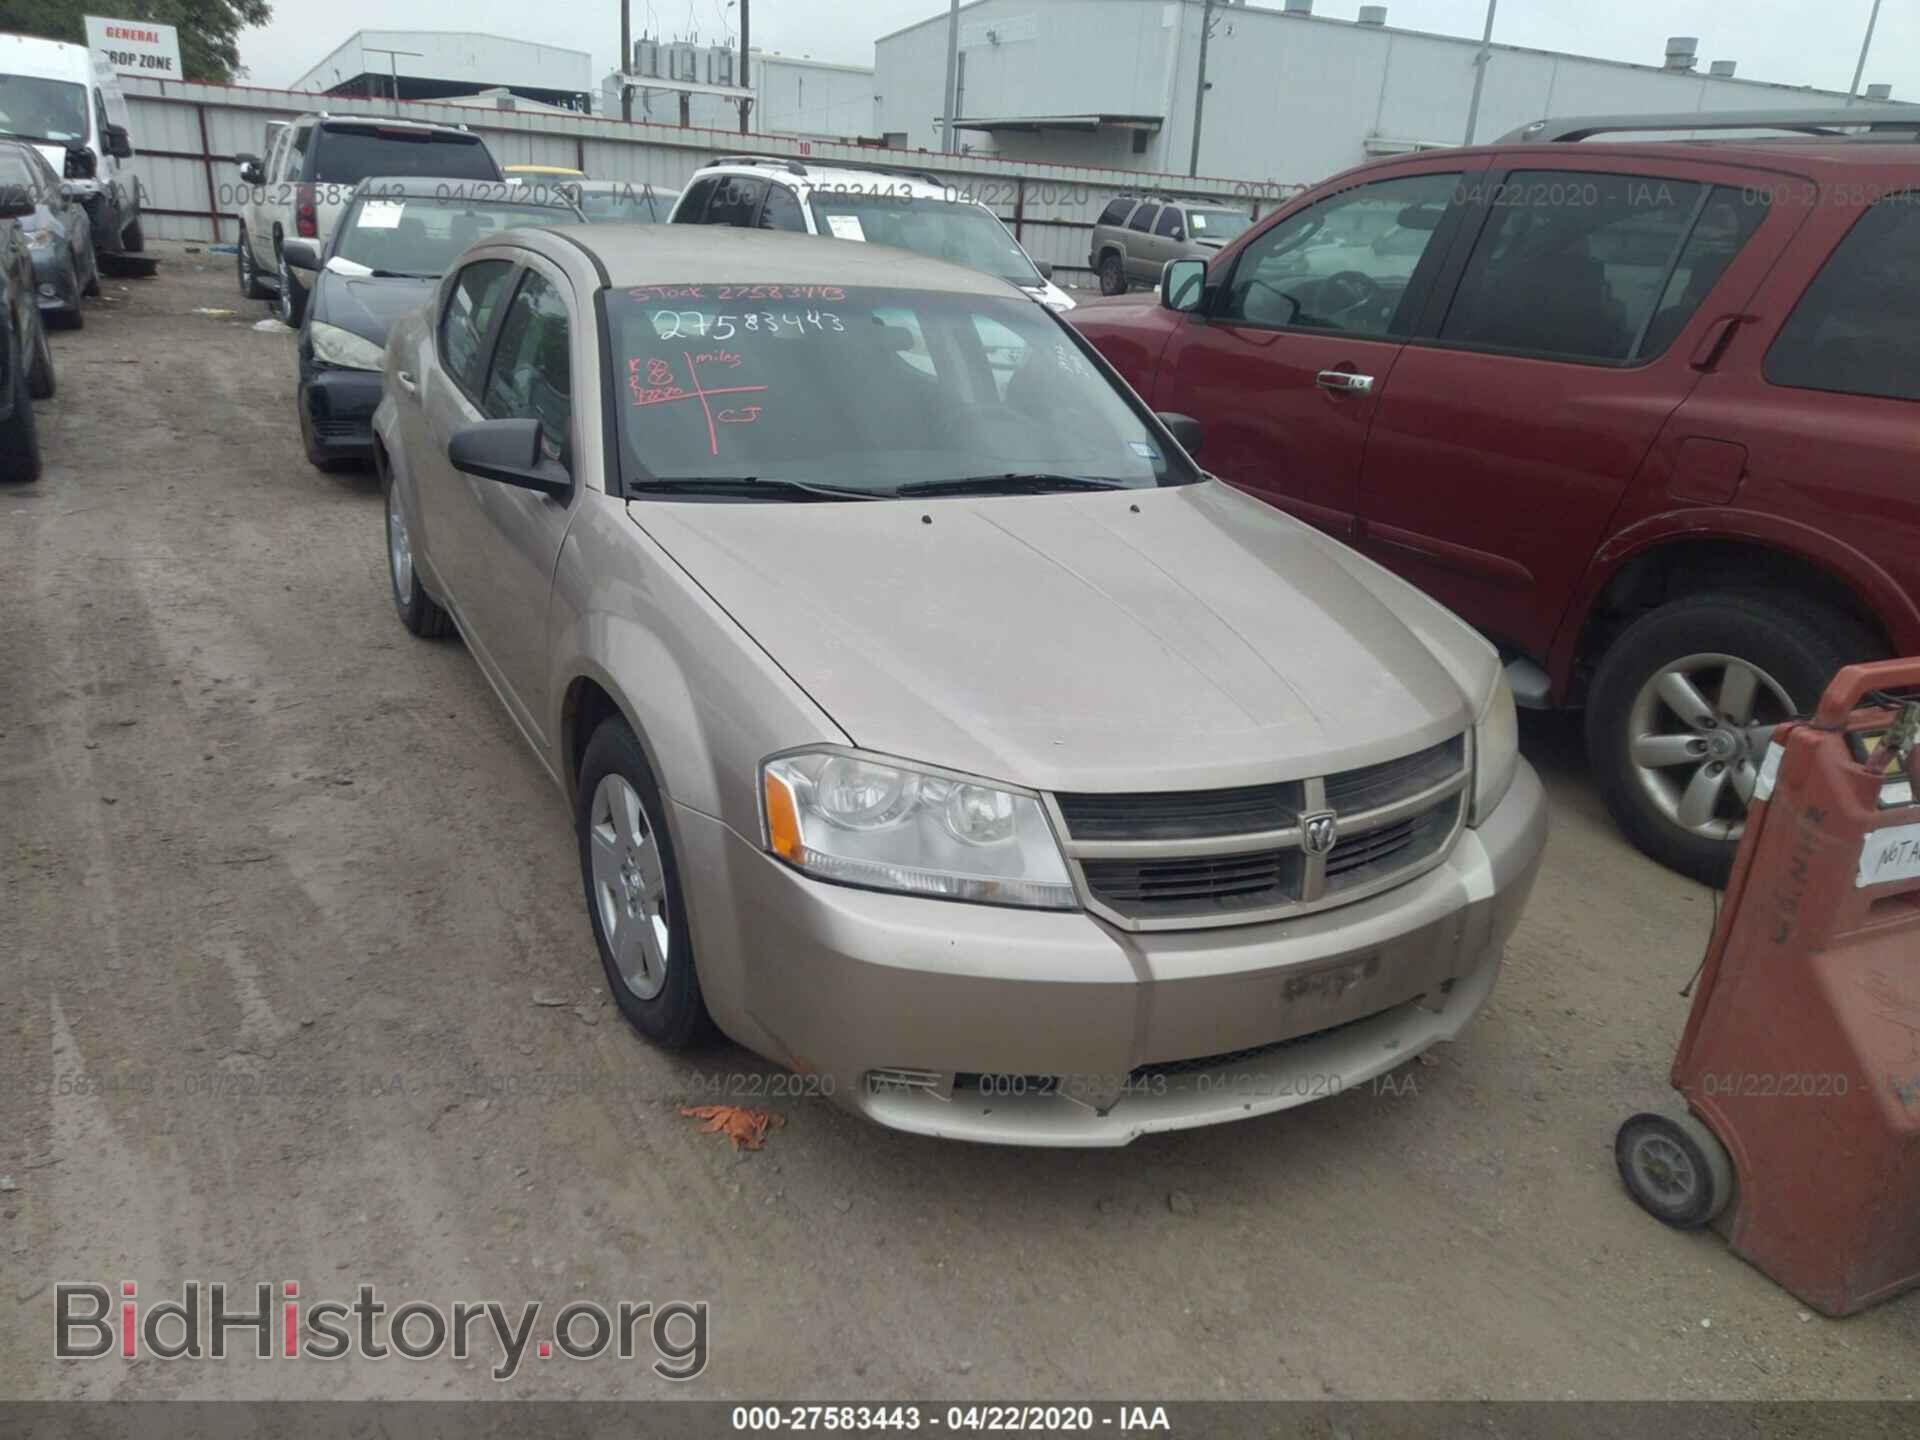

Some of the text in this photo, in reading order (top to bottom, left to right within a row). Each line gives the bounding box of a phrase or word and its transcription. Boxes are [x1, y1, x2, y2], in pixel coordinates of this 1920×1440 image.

[106, 26, 159, 43] GENERAL
[101, 48, 172, 71] ROP ZONE
[653, 309, 845, 340] 27583443
[1874, 839, 1912, 874] NOT
